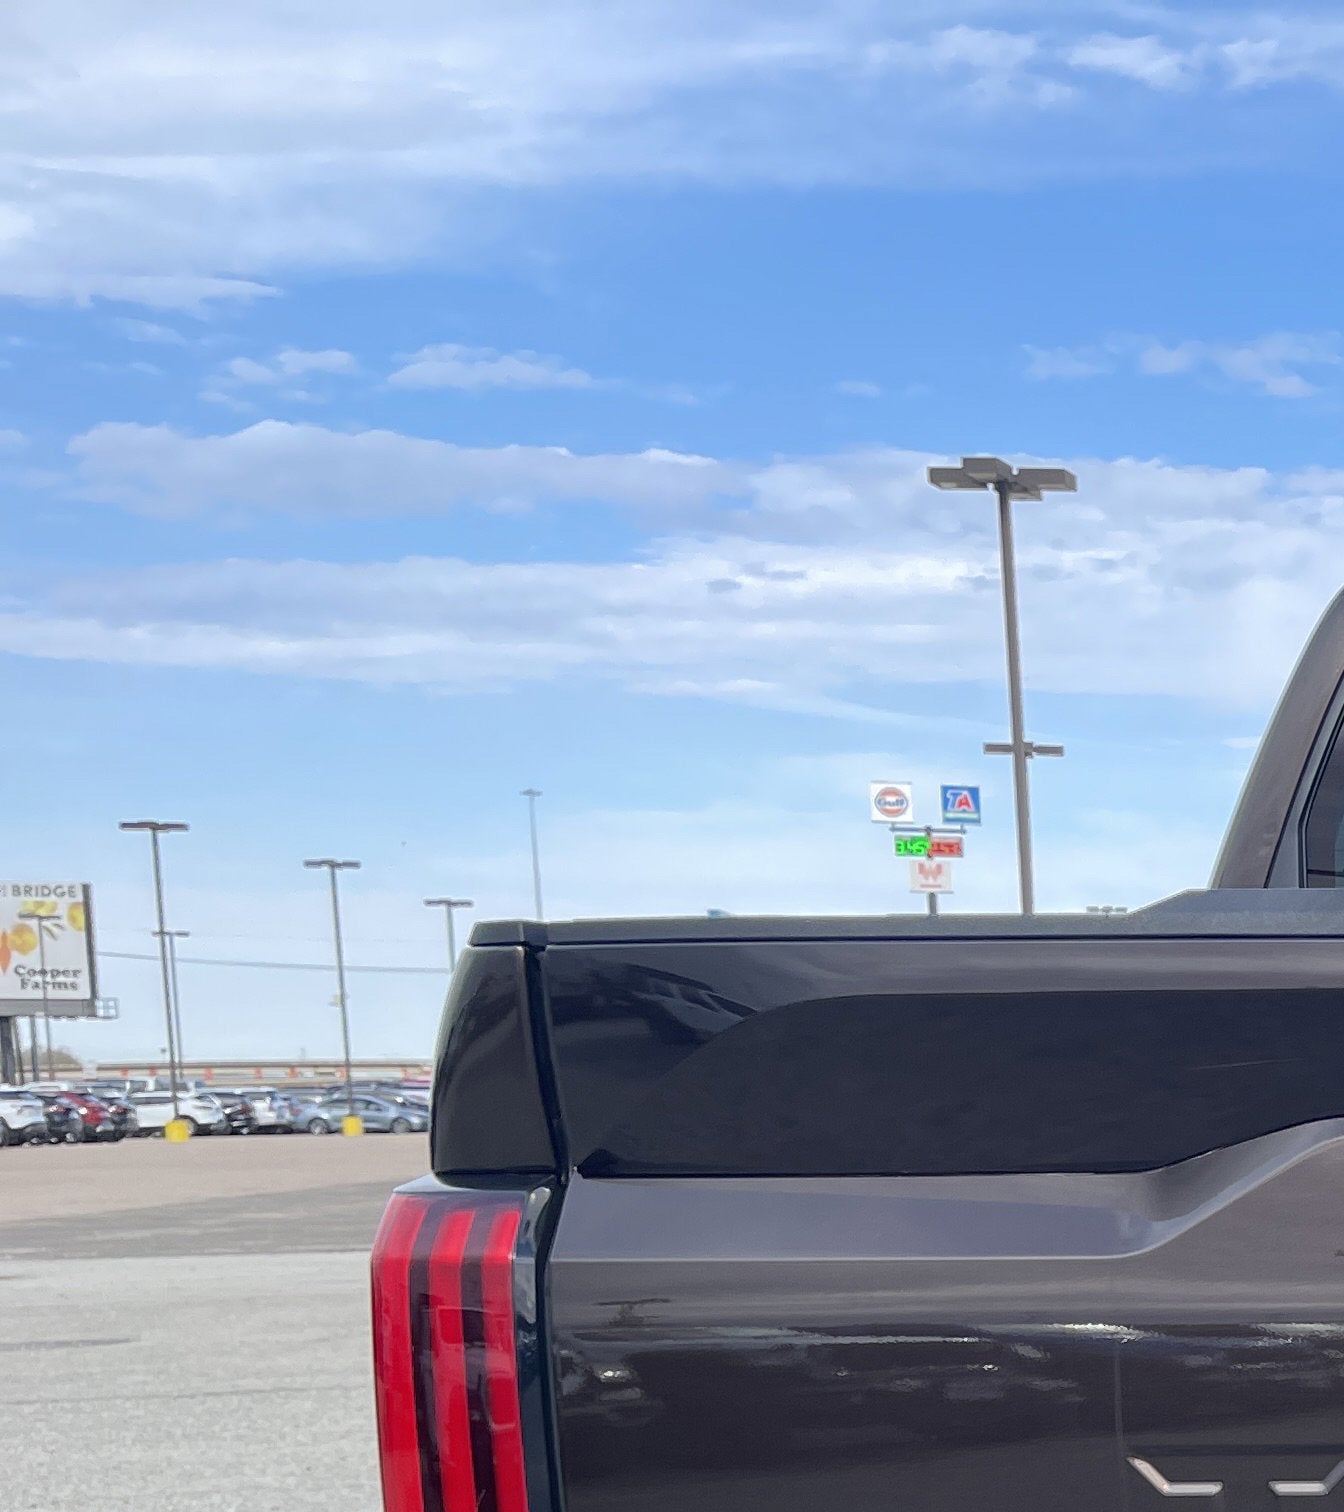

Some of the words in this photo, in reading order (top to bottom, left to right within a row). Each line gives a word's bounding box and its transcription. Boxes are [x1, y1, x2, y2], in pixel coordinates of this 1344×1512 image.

[945, 789, 975, 812] TA
[11, 884, 77, 898] BRIDGE
[14, 964, 82, 979] Cooper
[20, 978, 79, 991] Farms
